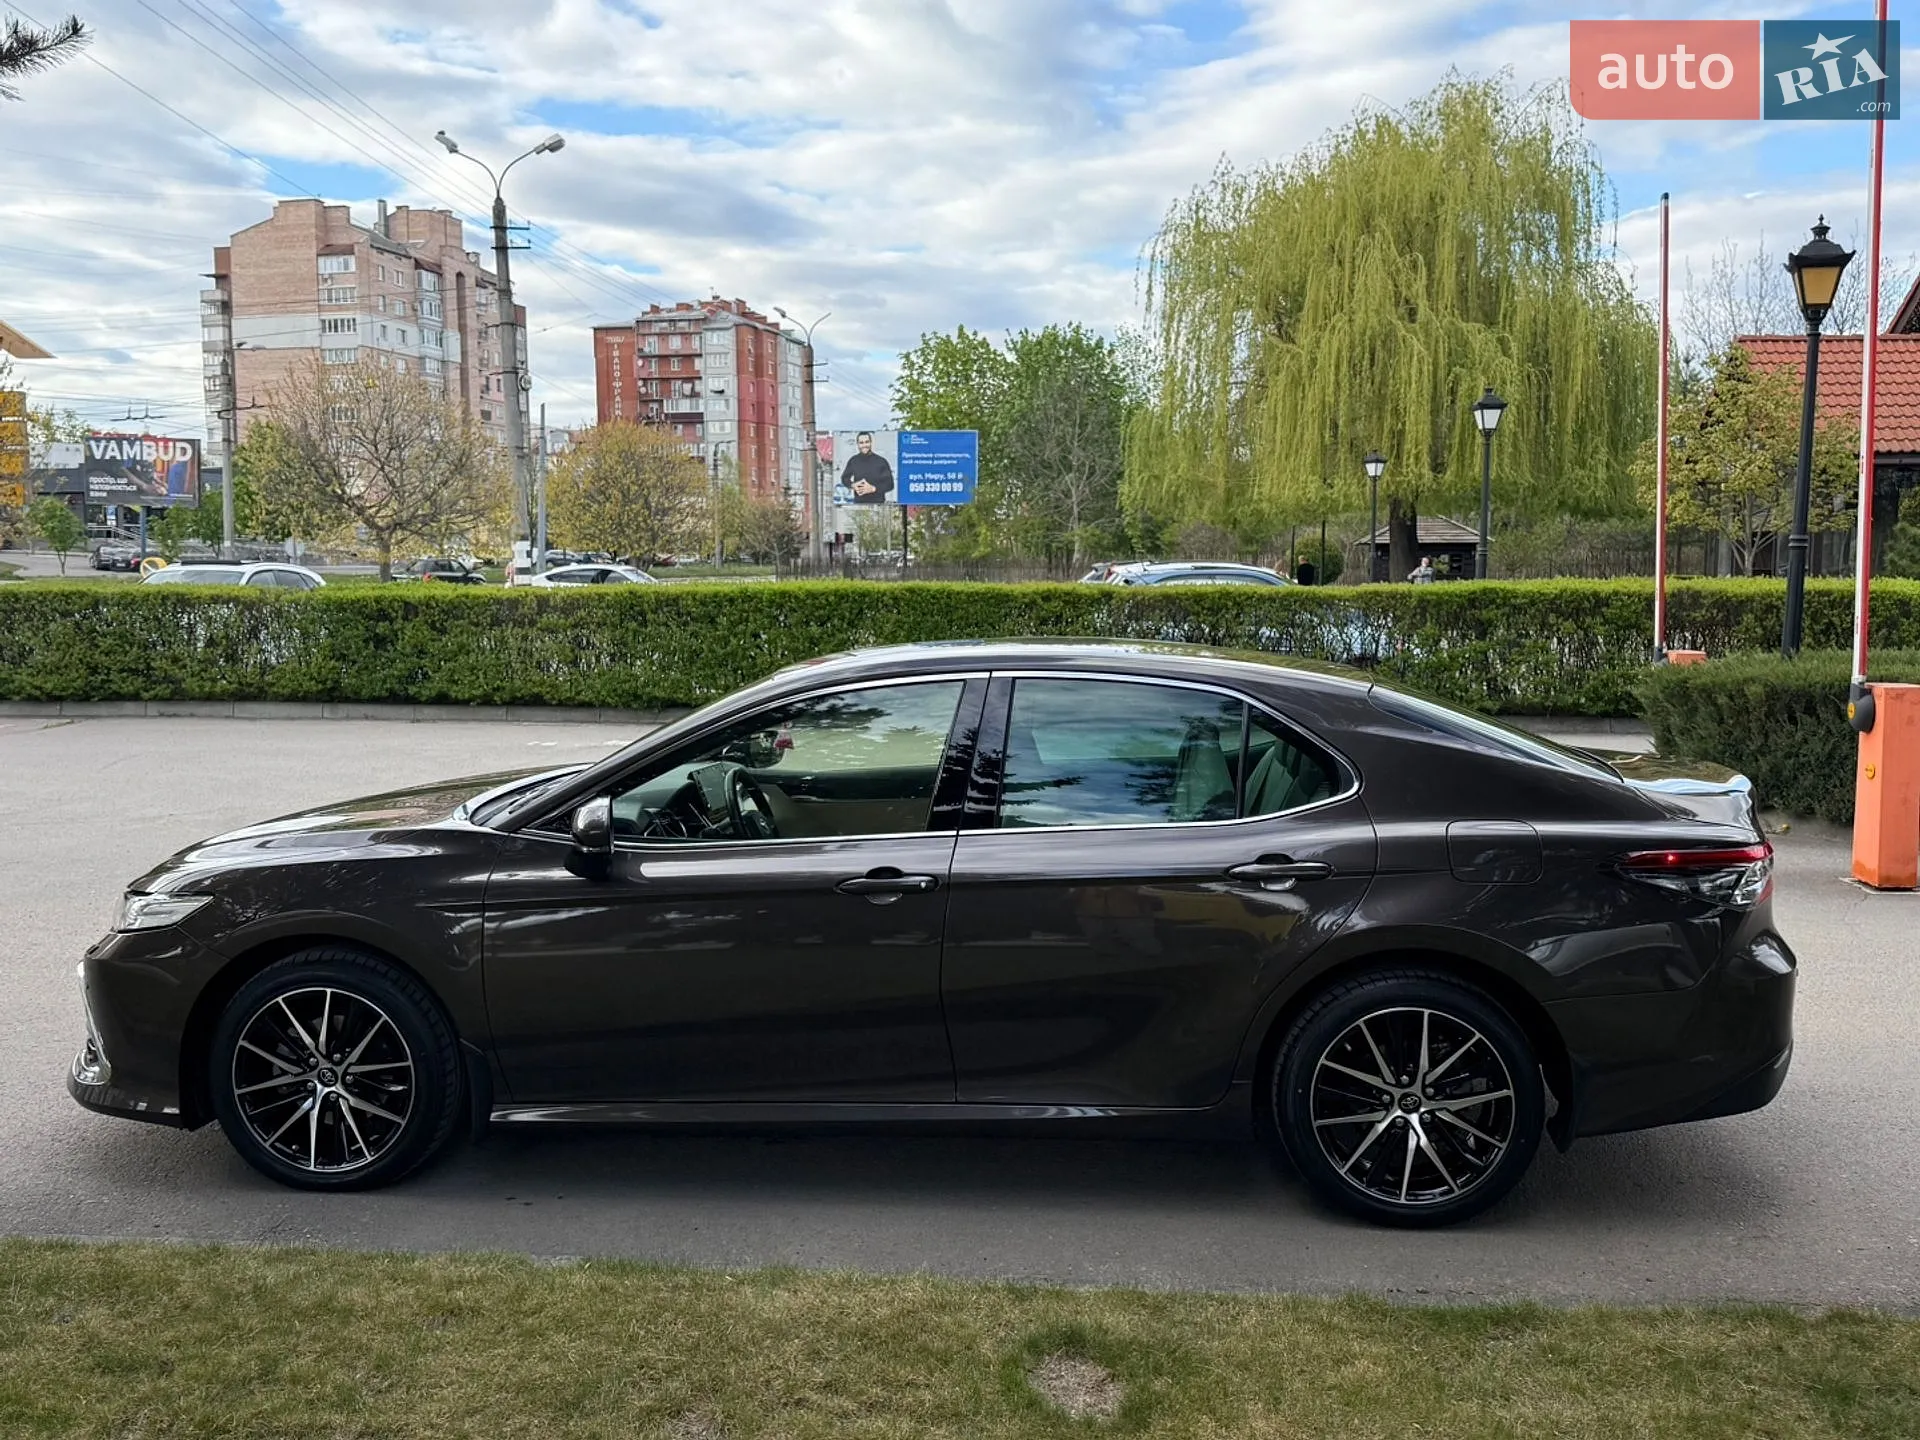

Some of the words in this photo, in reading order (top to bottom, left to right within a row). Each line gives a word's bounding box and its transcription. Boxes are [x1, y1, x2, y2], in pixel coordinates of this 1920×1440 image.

[89, 440, 193, 461] VAMBUD
[909, 482, 925, 493] 050
[925, 482, 940, 493] 330
[941, 482, 952, 493] 00
[952, 482, 964, 493] 99
